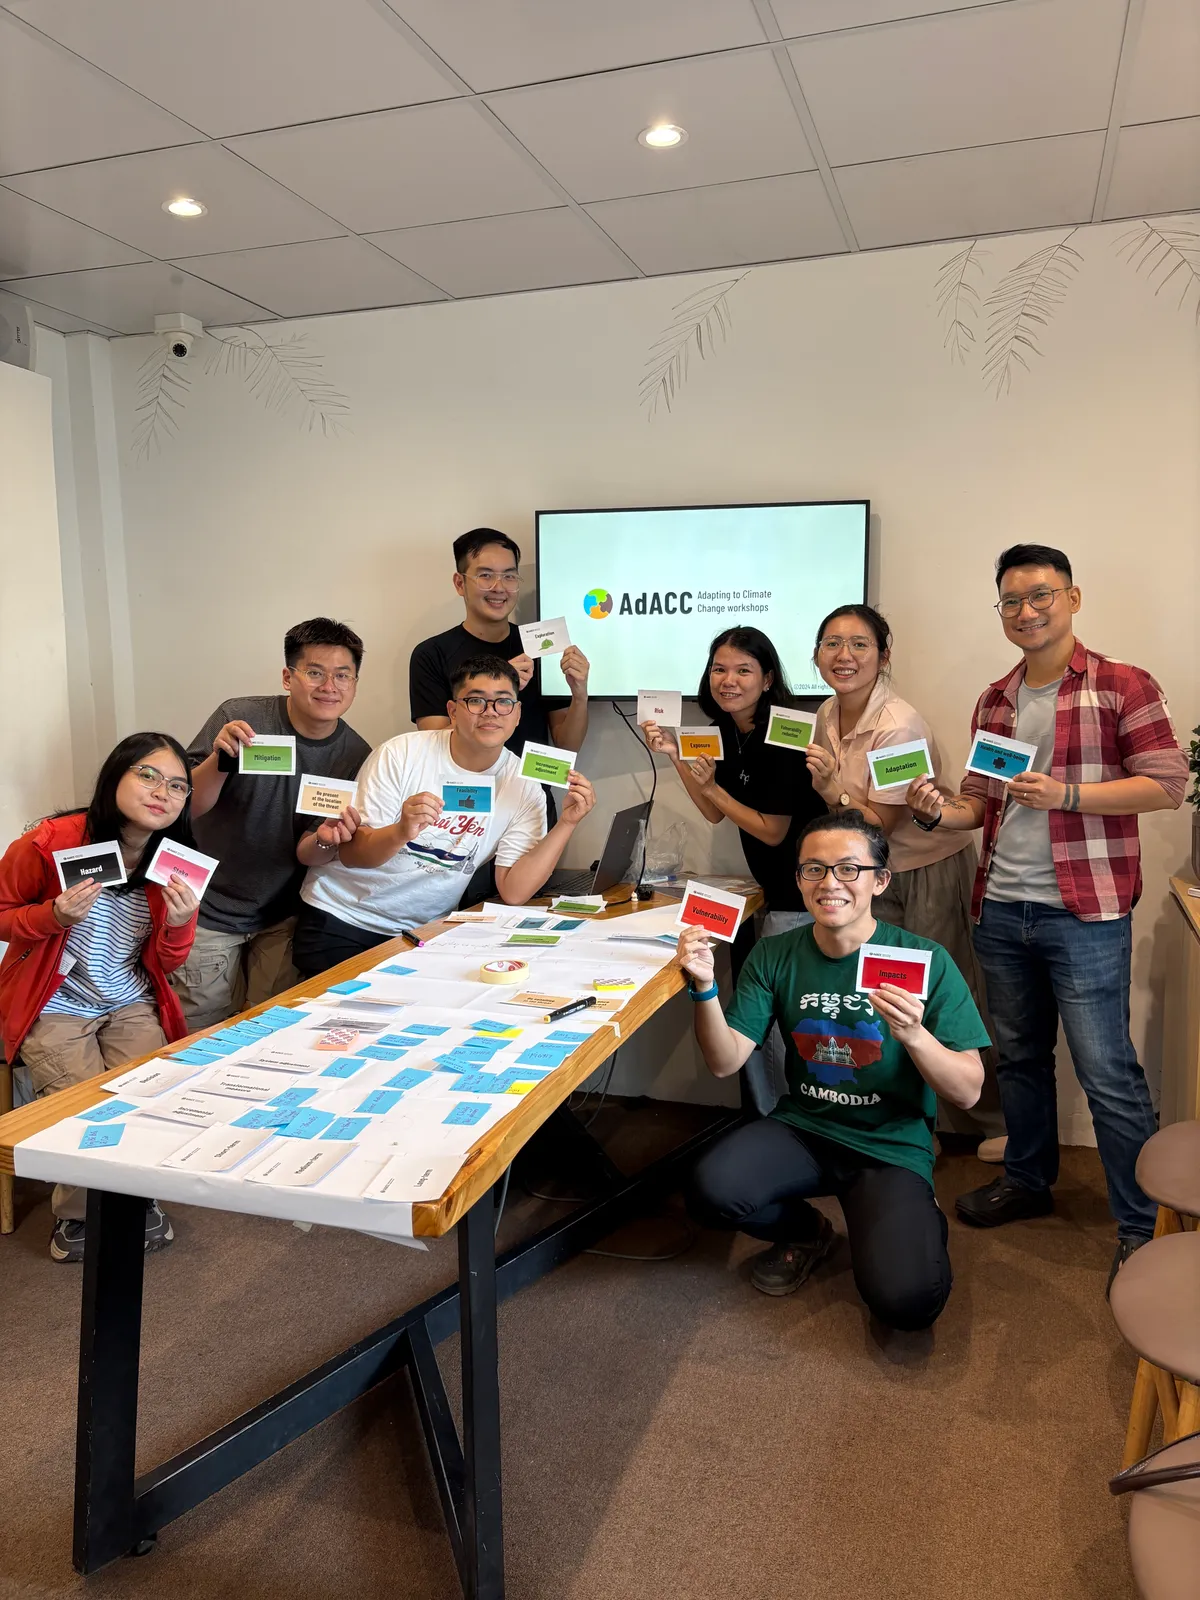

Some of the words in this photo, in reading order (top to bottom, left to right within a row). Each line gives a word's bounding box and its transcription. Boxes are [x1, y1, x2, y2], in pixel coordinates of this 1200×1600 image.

[697, 590, 731, 601] Adapting
[733, 590, 741, 599] to
[742, 589, 772, 599] Climate
[619, 591, 693, 616] AdACC
[697, 603, 726, 615] Change
[727, 602, 769, 614] workshops
[534, 631, 555, 639] Exploration
[780, 724, 802, 735] Vulnerability
[254, 754, 282, 763] Mitigation
[535, 760, 559, 770] Incremental
[885, 761, 918, 774] Adaptation
[449, 814, 485, 837] Yên
[80, 864, 103, 876] Hazard
[692, 906, 728, 925] Vulnerability
[879, 969, 907, 980] Impacts
[220, 1082, 270, 1092] Transformational
[800, 1082, 882, 1106] CAMBODIA
[172, 1110, 206, 1119] adjustment
[178, 1106, 214, 1116] Incremental
[214, 1139, 241, 1160] Short-term
[294, 1152, 324, 1176] Medium-term
[414, 1168, 434, 1188] Long-term
